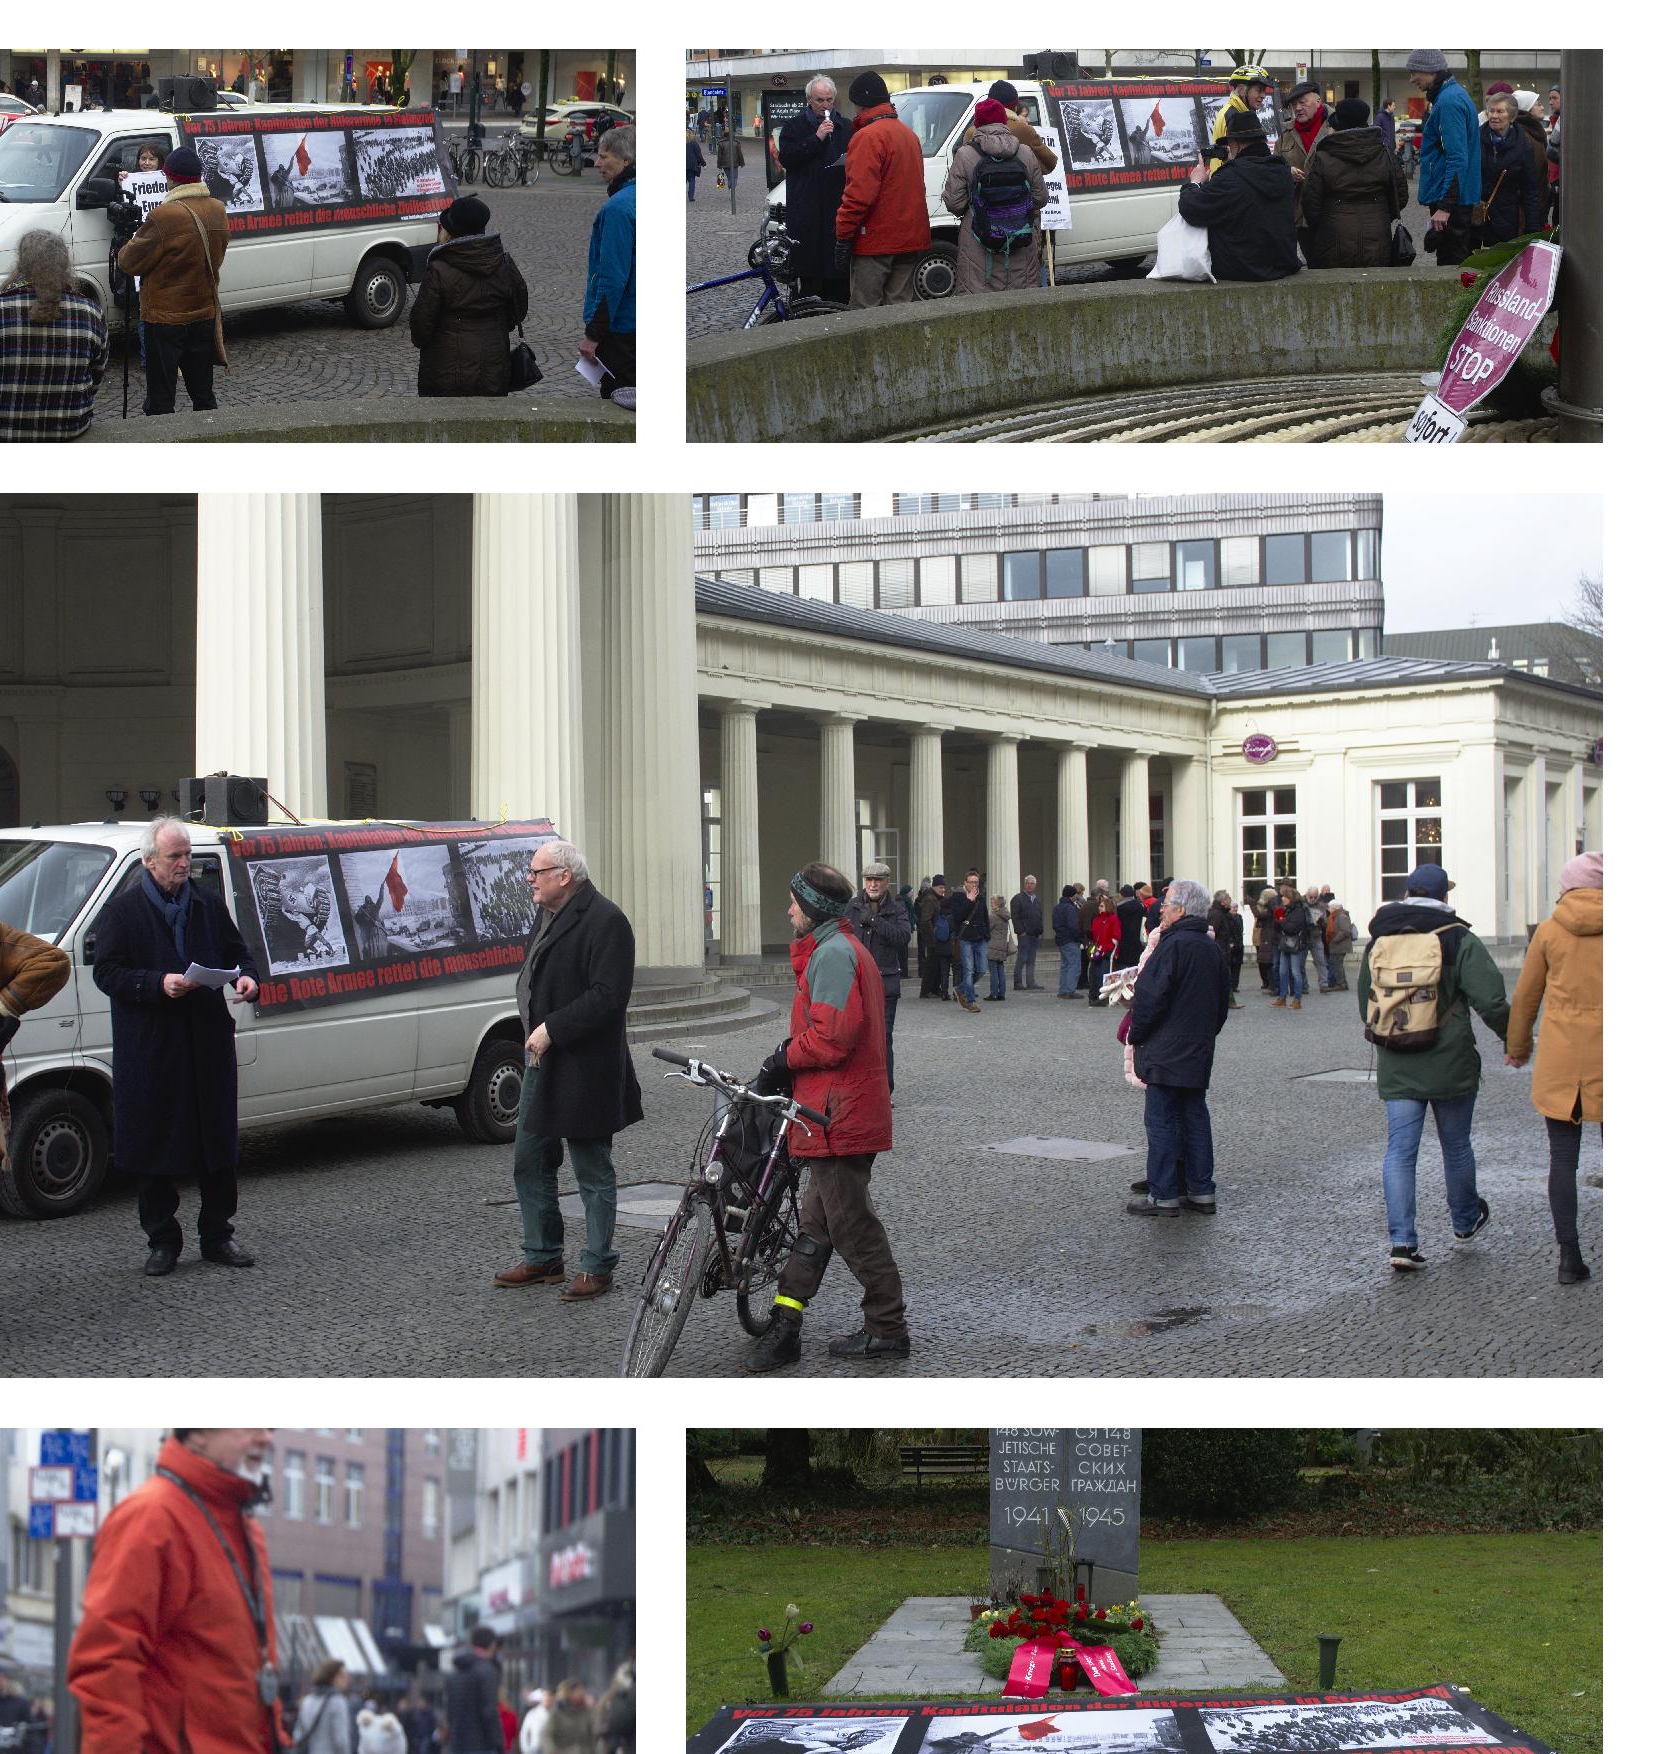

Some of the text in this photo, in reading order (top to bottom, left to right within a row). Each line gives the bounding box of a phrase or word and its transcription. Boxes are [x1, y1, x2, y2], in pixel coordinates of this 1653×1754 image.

[1465, 311, 1522, 355] Sanktionen
[1449, 343, 1495, 385] STOP
[328, 969, 376, 994] Armee
[998, 1441, 1057, 1455] JETISCHE
[1075, 1443, 1133, 1457] СОВЕТ-
[1003, 1460, 1055, 1474] STAATS-
[1078, 1461, 1127, 1475] СКИХ
[995, 1477, 1061, 1492] BÜRGER
[1071, 1479, 1138, 1494] ГРАЖДАН
[1004, 1505, 1049, 1528] 1941
[1079, 1506, 1127, 1528] 1945
[731, 1701, 1082, 1720] Vor Jahren: Kapitulation
